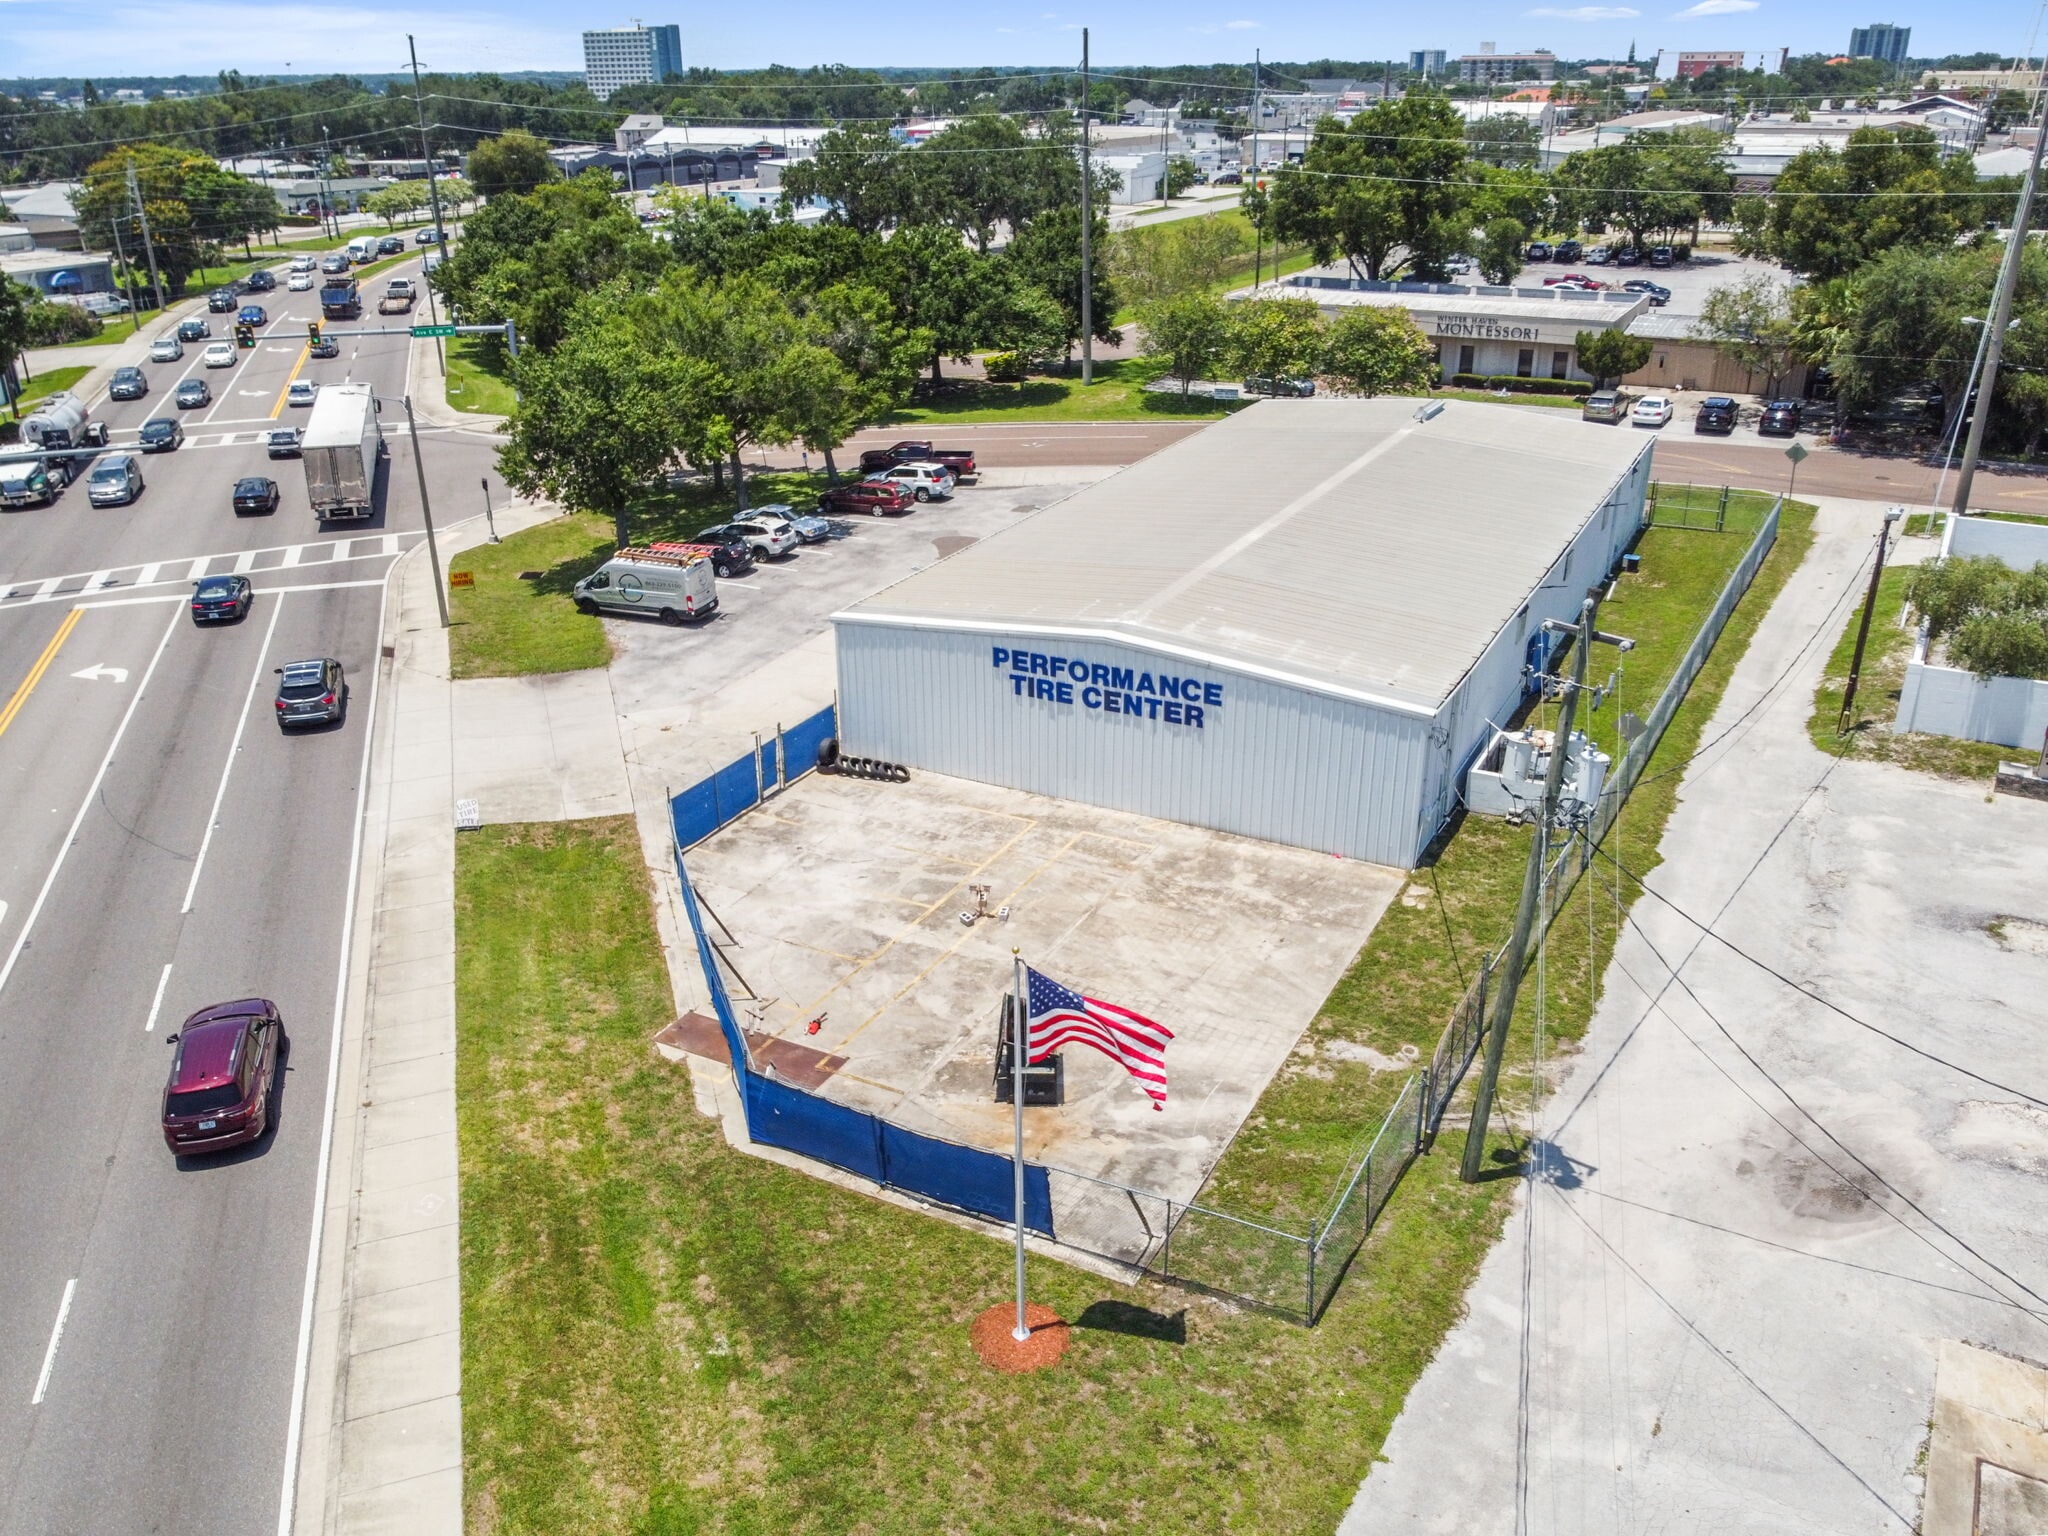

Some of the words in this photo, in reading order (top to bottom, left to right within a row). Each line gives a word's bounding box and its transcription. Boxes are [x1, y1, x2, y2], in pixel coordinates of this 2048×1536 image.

[1437, 315, 1467, 324] WINTER
[1472, 317, 1498, 325] HAVEN
[1436, 323, 1539, 340] MONTESSORI
[452, 578, 474, 586] HIRING
[992, 647, 1223, 707] PERFORMANCE
[1009, 674, 1073, 704] TIRE
[1082, 687, 1204, 729] CENTER
[457, 799, 477, 810] USED
[459, 807, 477, 818] TIRE
